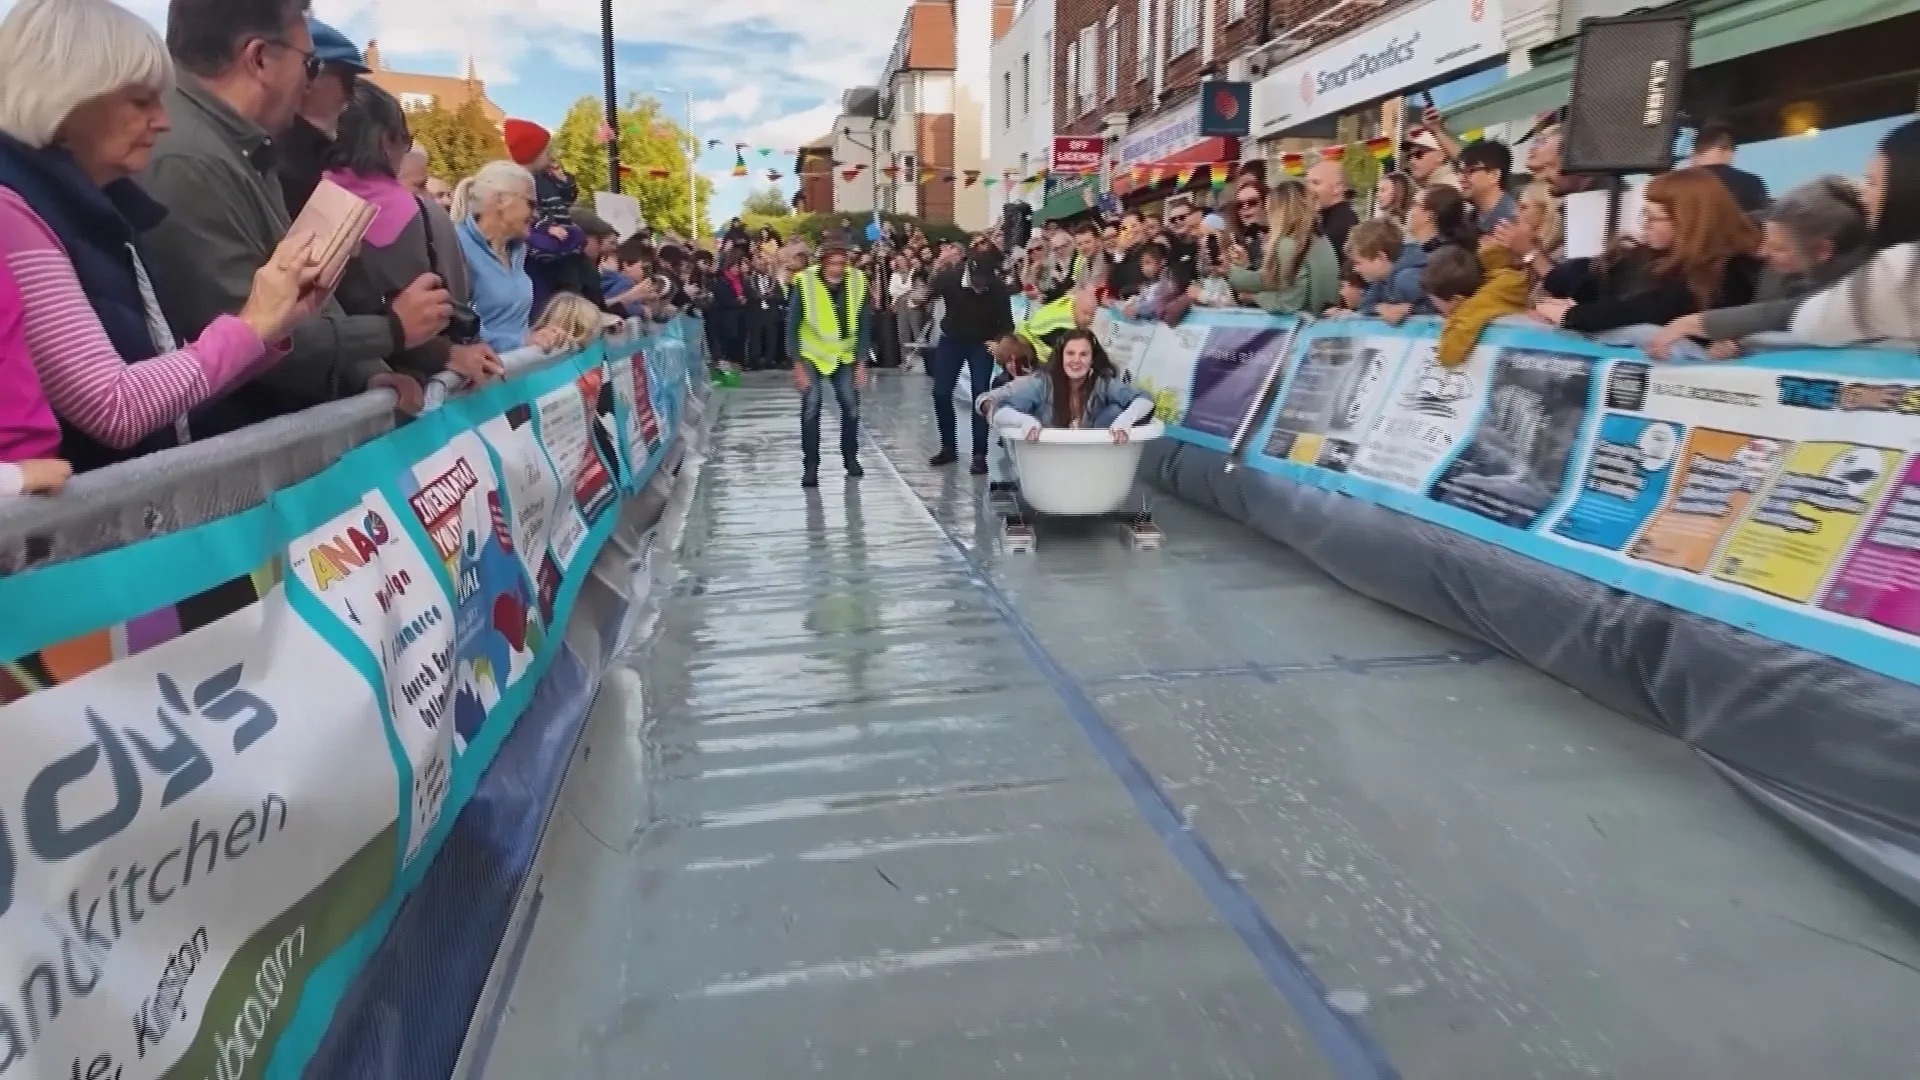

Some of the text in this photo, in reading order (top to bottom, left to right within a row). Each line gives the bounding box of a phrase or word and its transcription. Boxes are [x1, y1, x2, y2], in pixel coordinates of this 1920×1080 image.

[1068, 139, 1089, 151] OFF
[1777, 375, 1842, 410] THE
[132, 925, 209, 1060] Kingston
